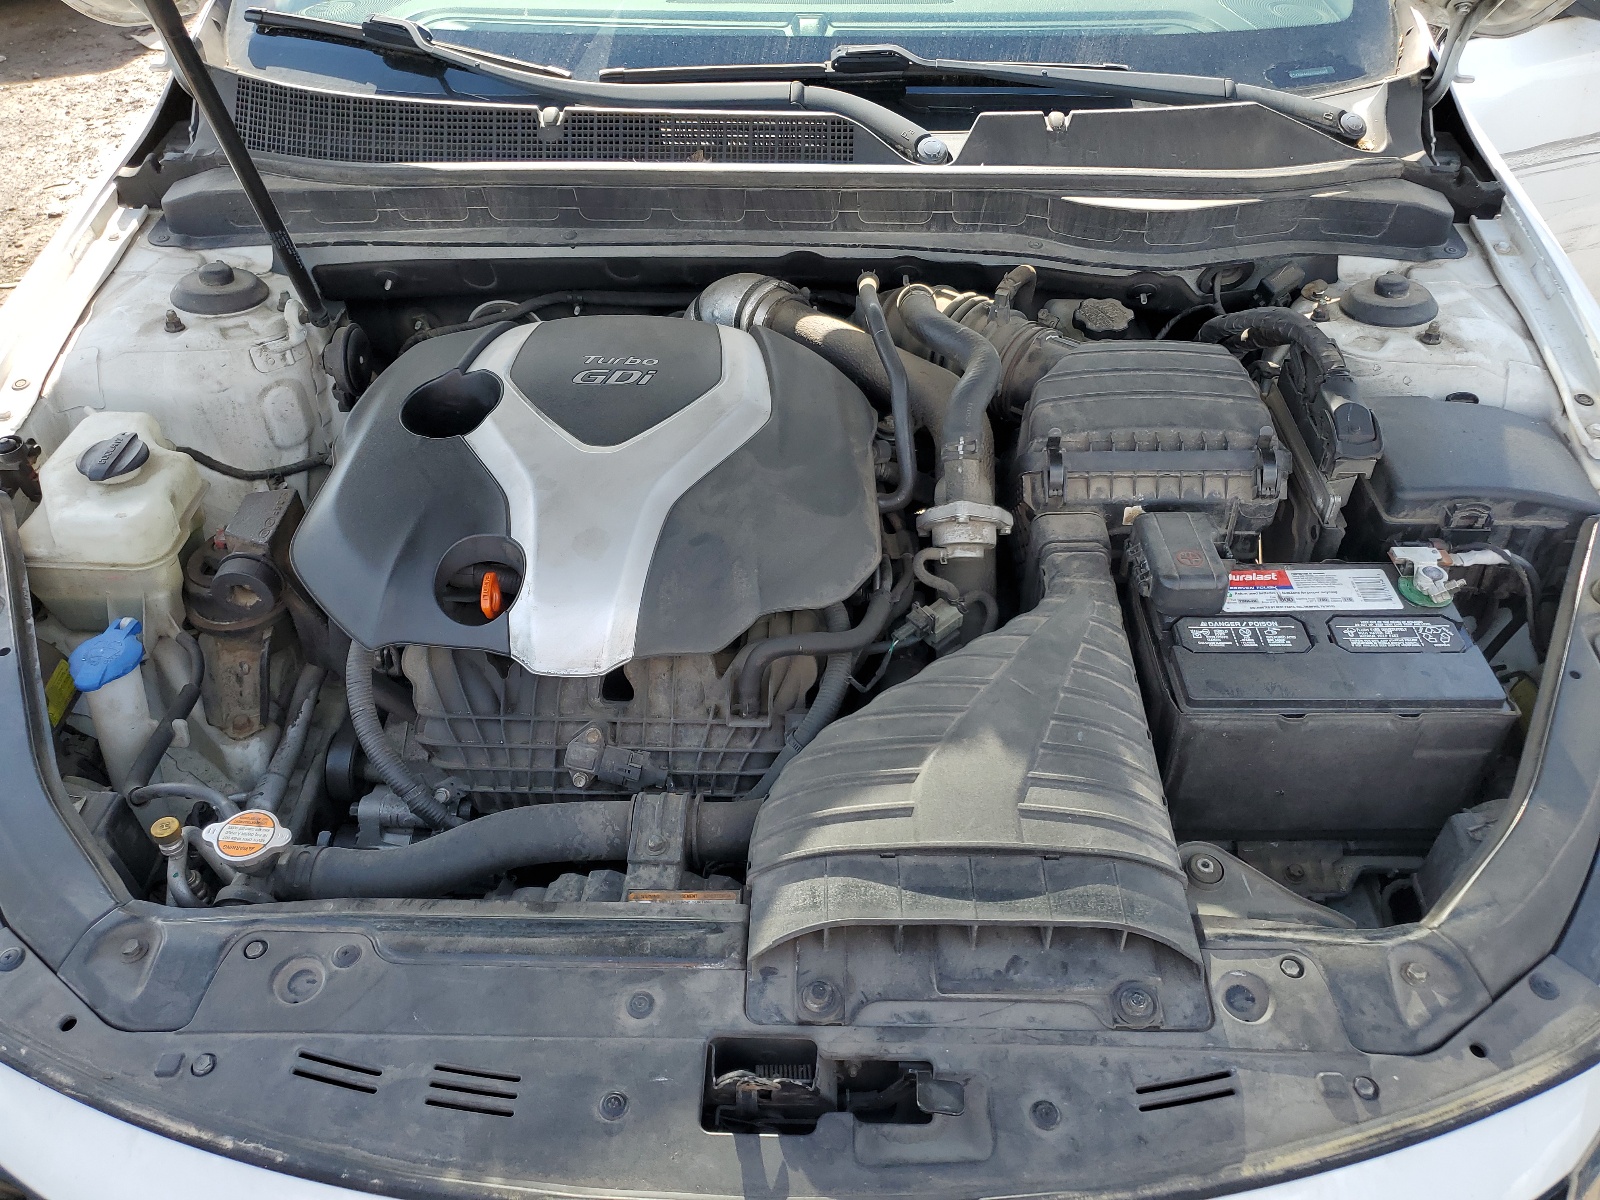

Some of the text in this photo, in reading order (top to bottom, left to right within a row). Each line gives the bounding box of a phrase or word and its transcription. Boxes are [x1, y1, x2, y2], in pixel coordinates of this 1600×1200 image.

[582, 355, 660, 366] Turbo
[572, 369, 658, 386] GDi
[1229, 573, 1278, 581] uralast
